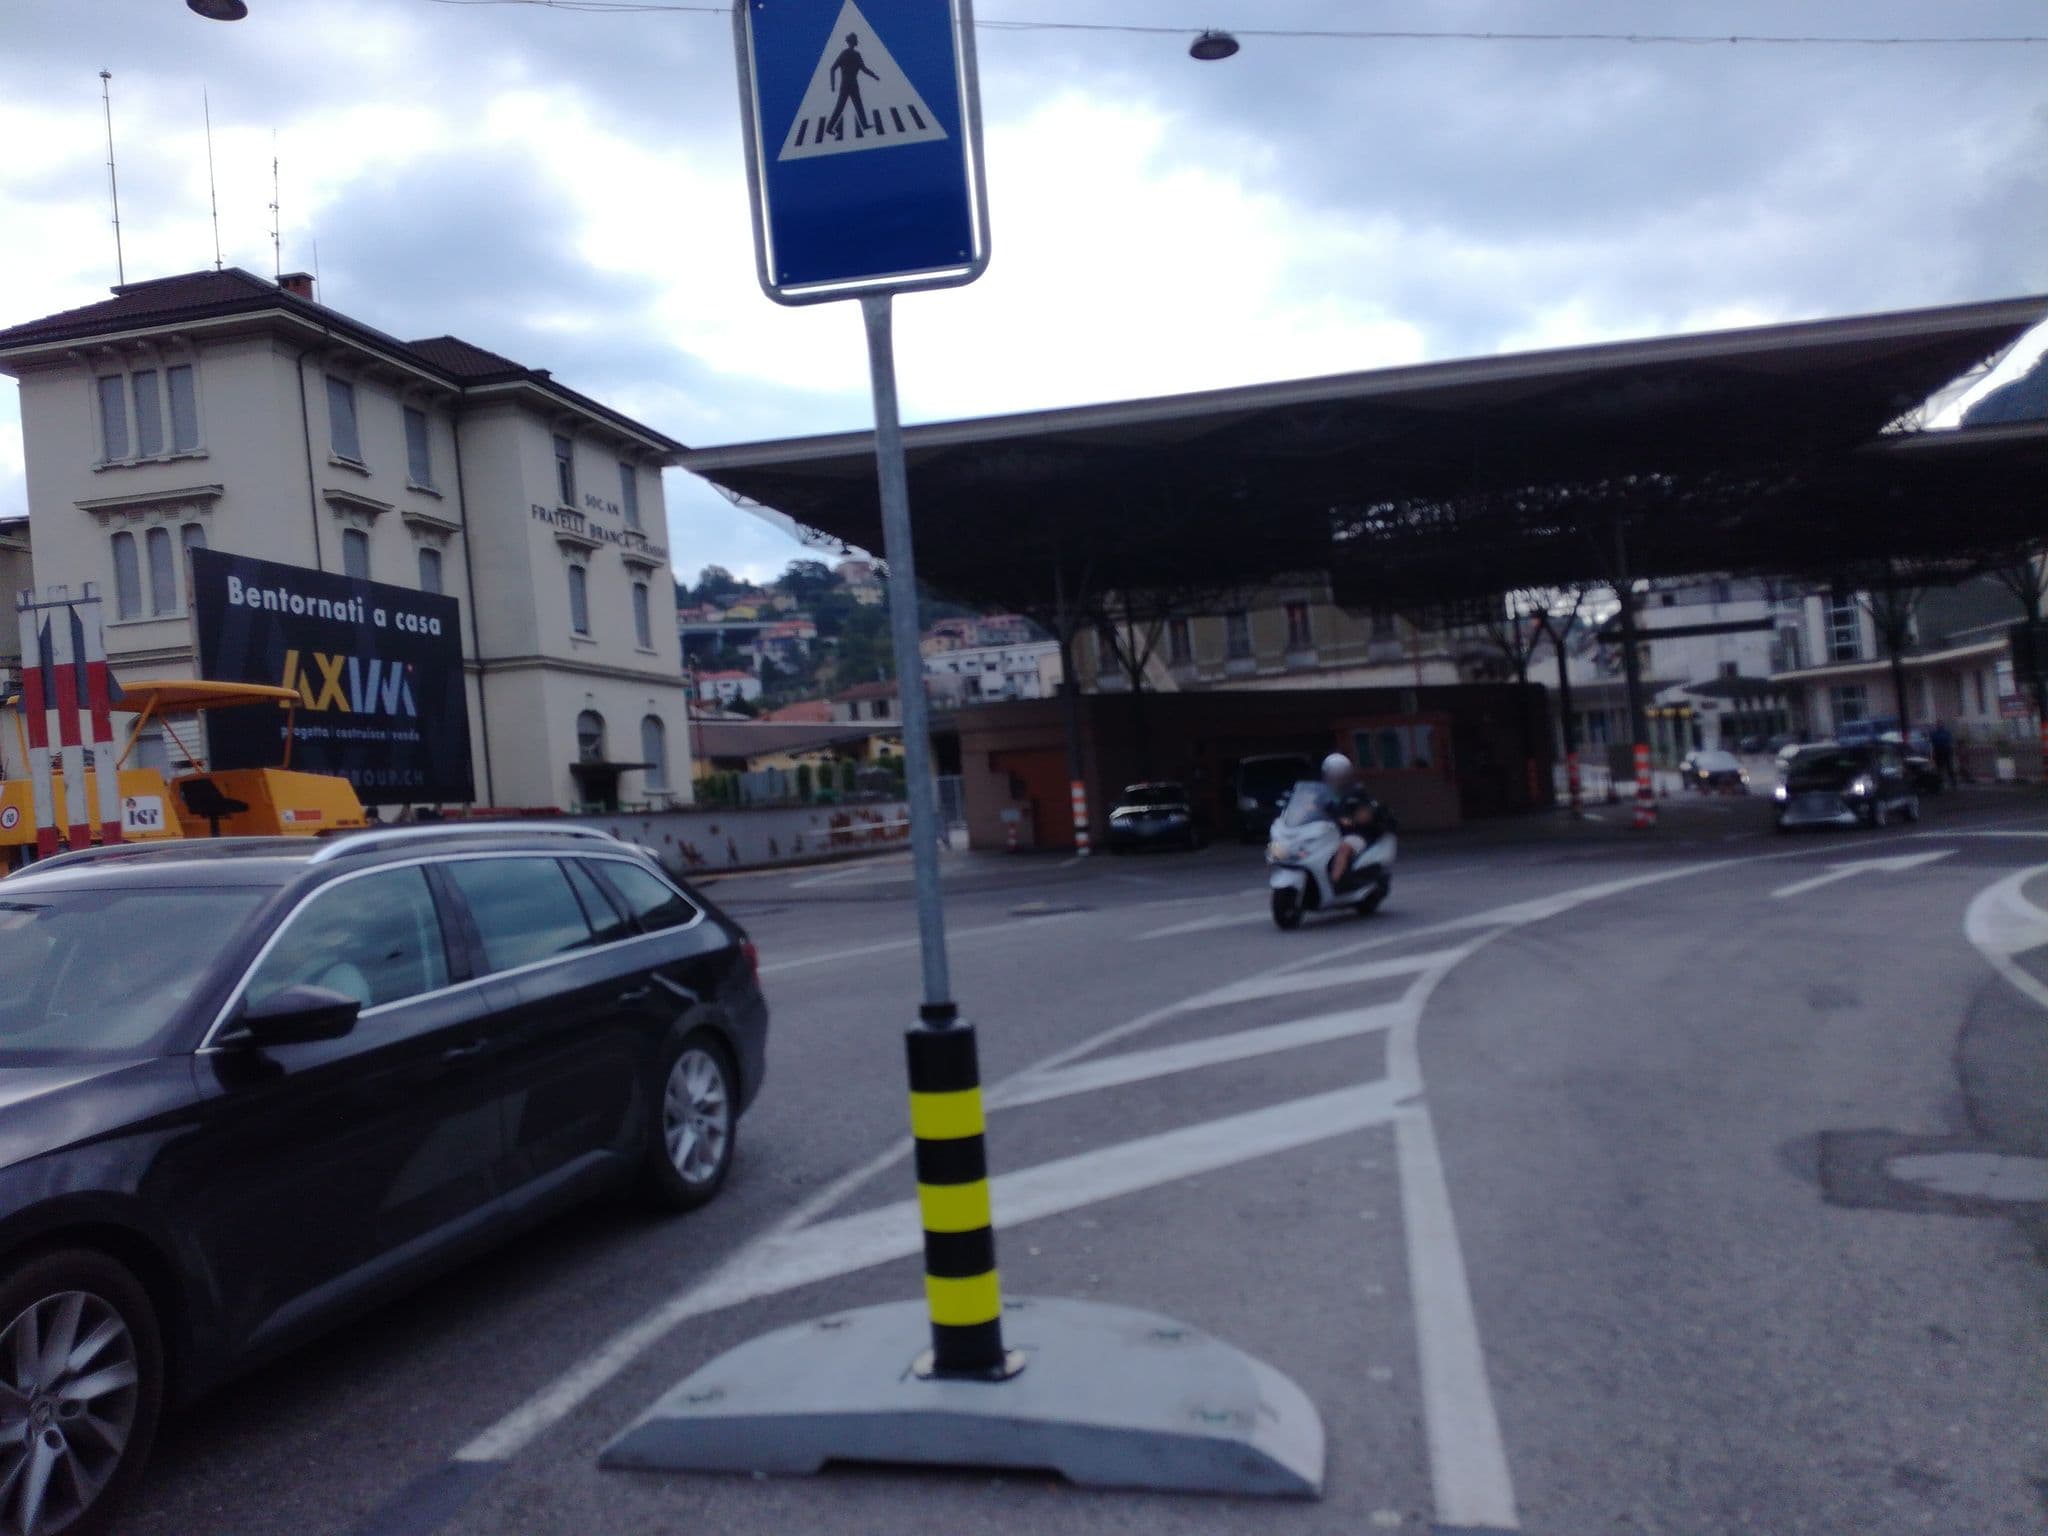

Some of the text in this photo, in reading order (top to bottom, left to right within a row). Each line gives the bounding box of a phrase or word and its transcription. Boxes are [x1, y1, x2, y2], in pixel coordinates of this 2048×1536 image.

[531, 504, 584, 533] FRATELLI
[590, 524, 630, 547] BRANCA
[227, 576, 441, 636] Bentornati a casa
